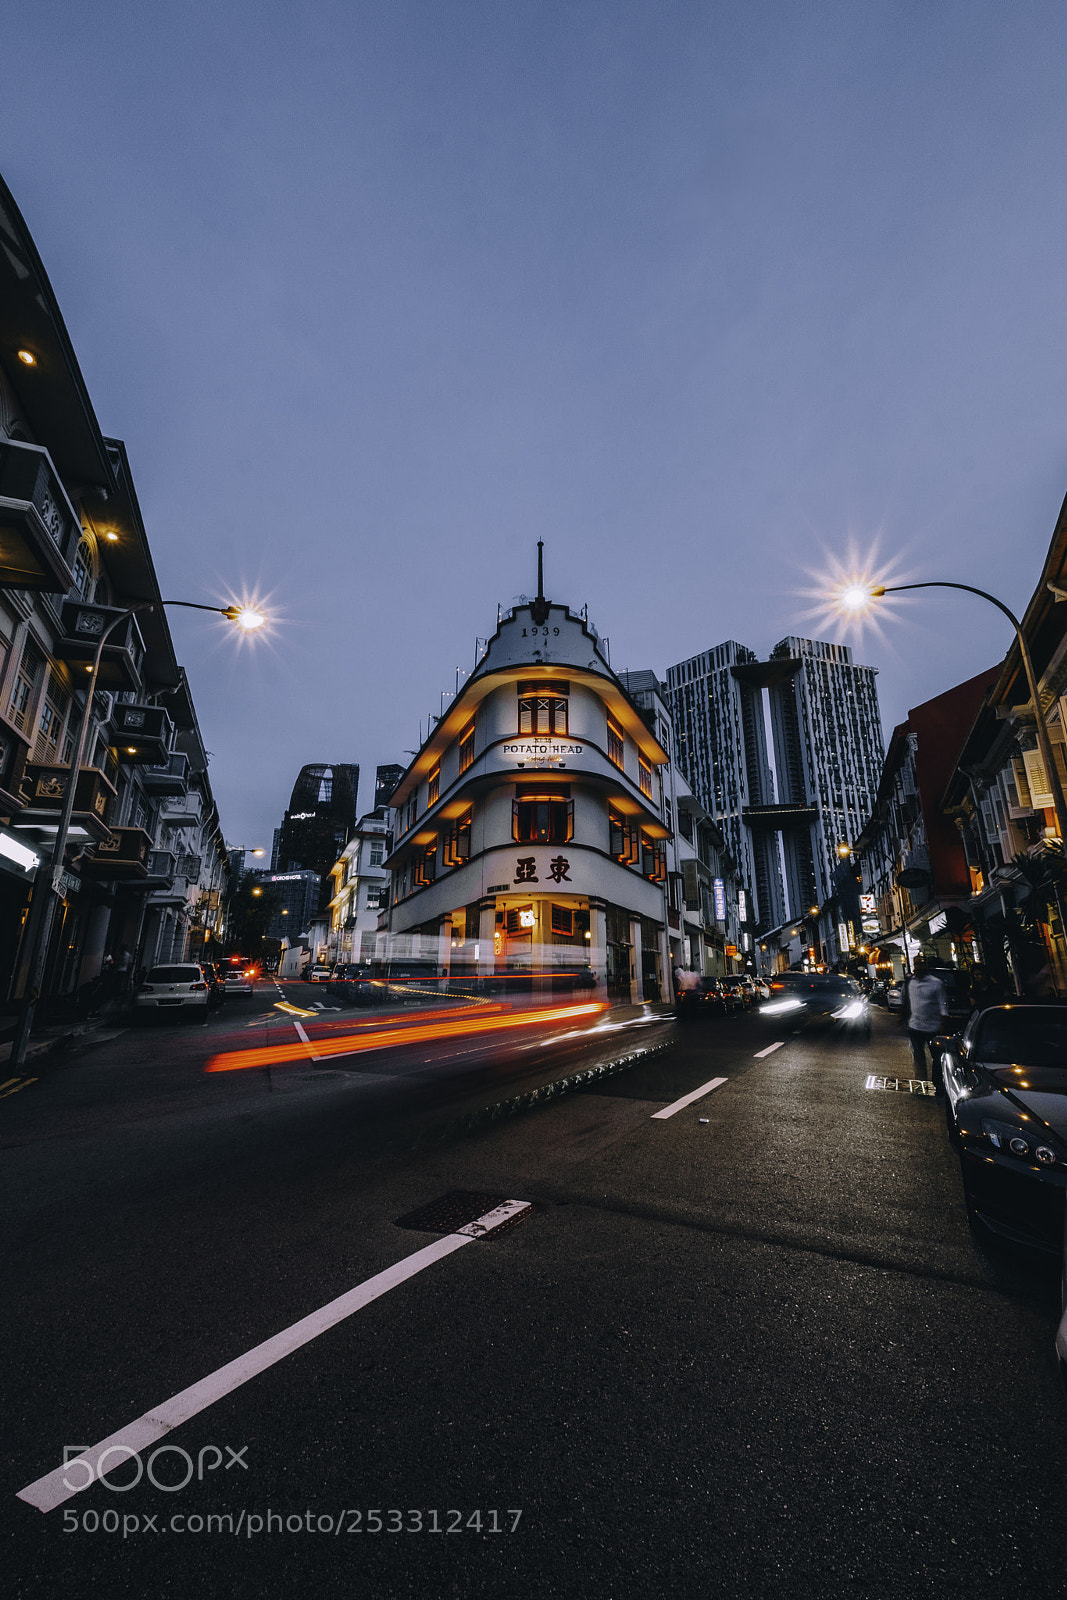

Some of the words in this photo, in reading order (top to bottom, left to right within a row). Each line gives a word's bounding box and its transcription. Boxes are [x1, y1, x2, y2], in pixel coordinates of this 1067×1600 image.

[522, 626, 560, 638] 1939
[503, 745, 547, 754] POTATO
[553, 745, 583, 754] HEAD
